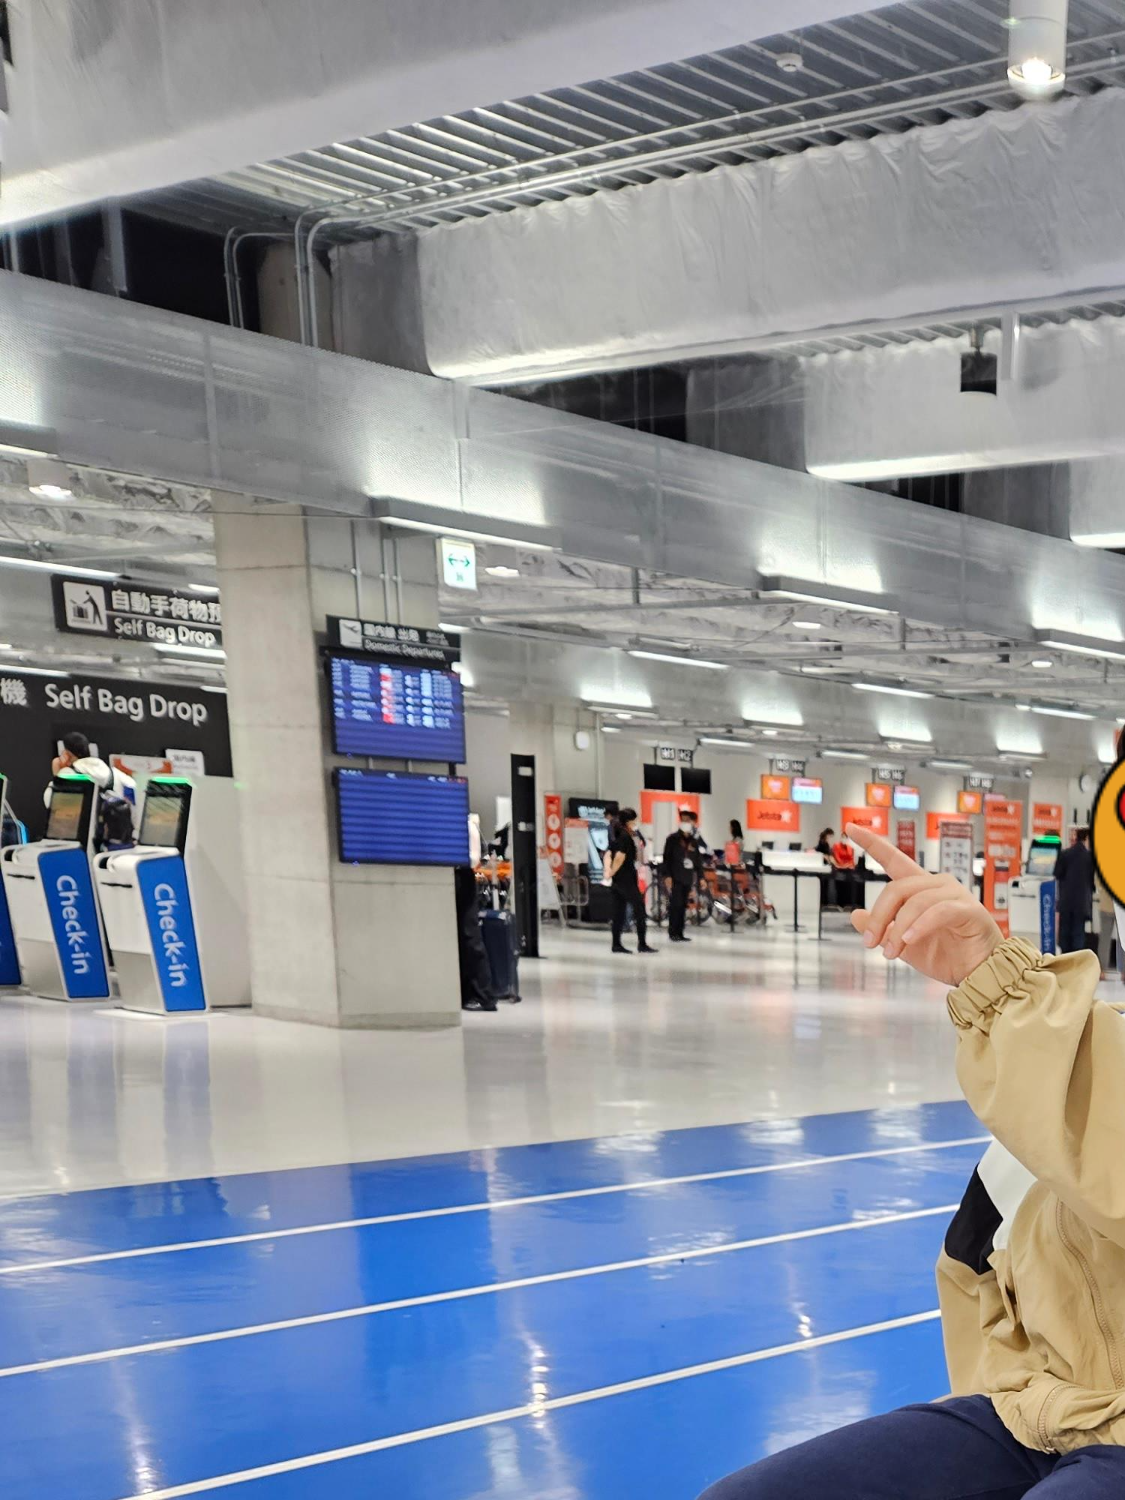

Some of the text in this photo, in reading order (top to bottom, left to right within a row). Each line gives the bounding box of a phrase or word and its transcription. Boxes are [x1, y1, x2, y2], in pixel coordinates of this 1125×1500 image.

[114, 617, 216, 647] Self Bag Drop
[45, 683, 207, 726] Self Bag Drop
[56, 875, 90, 974] Check-in
[154, 883, 190, 987] Check-in
